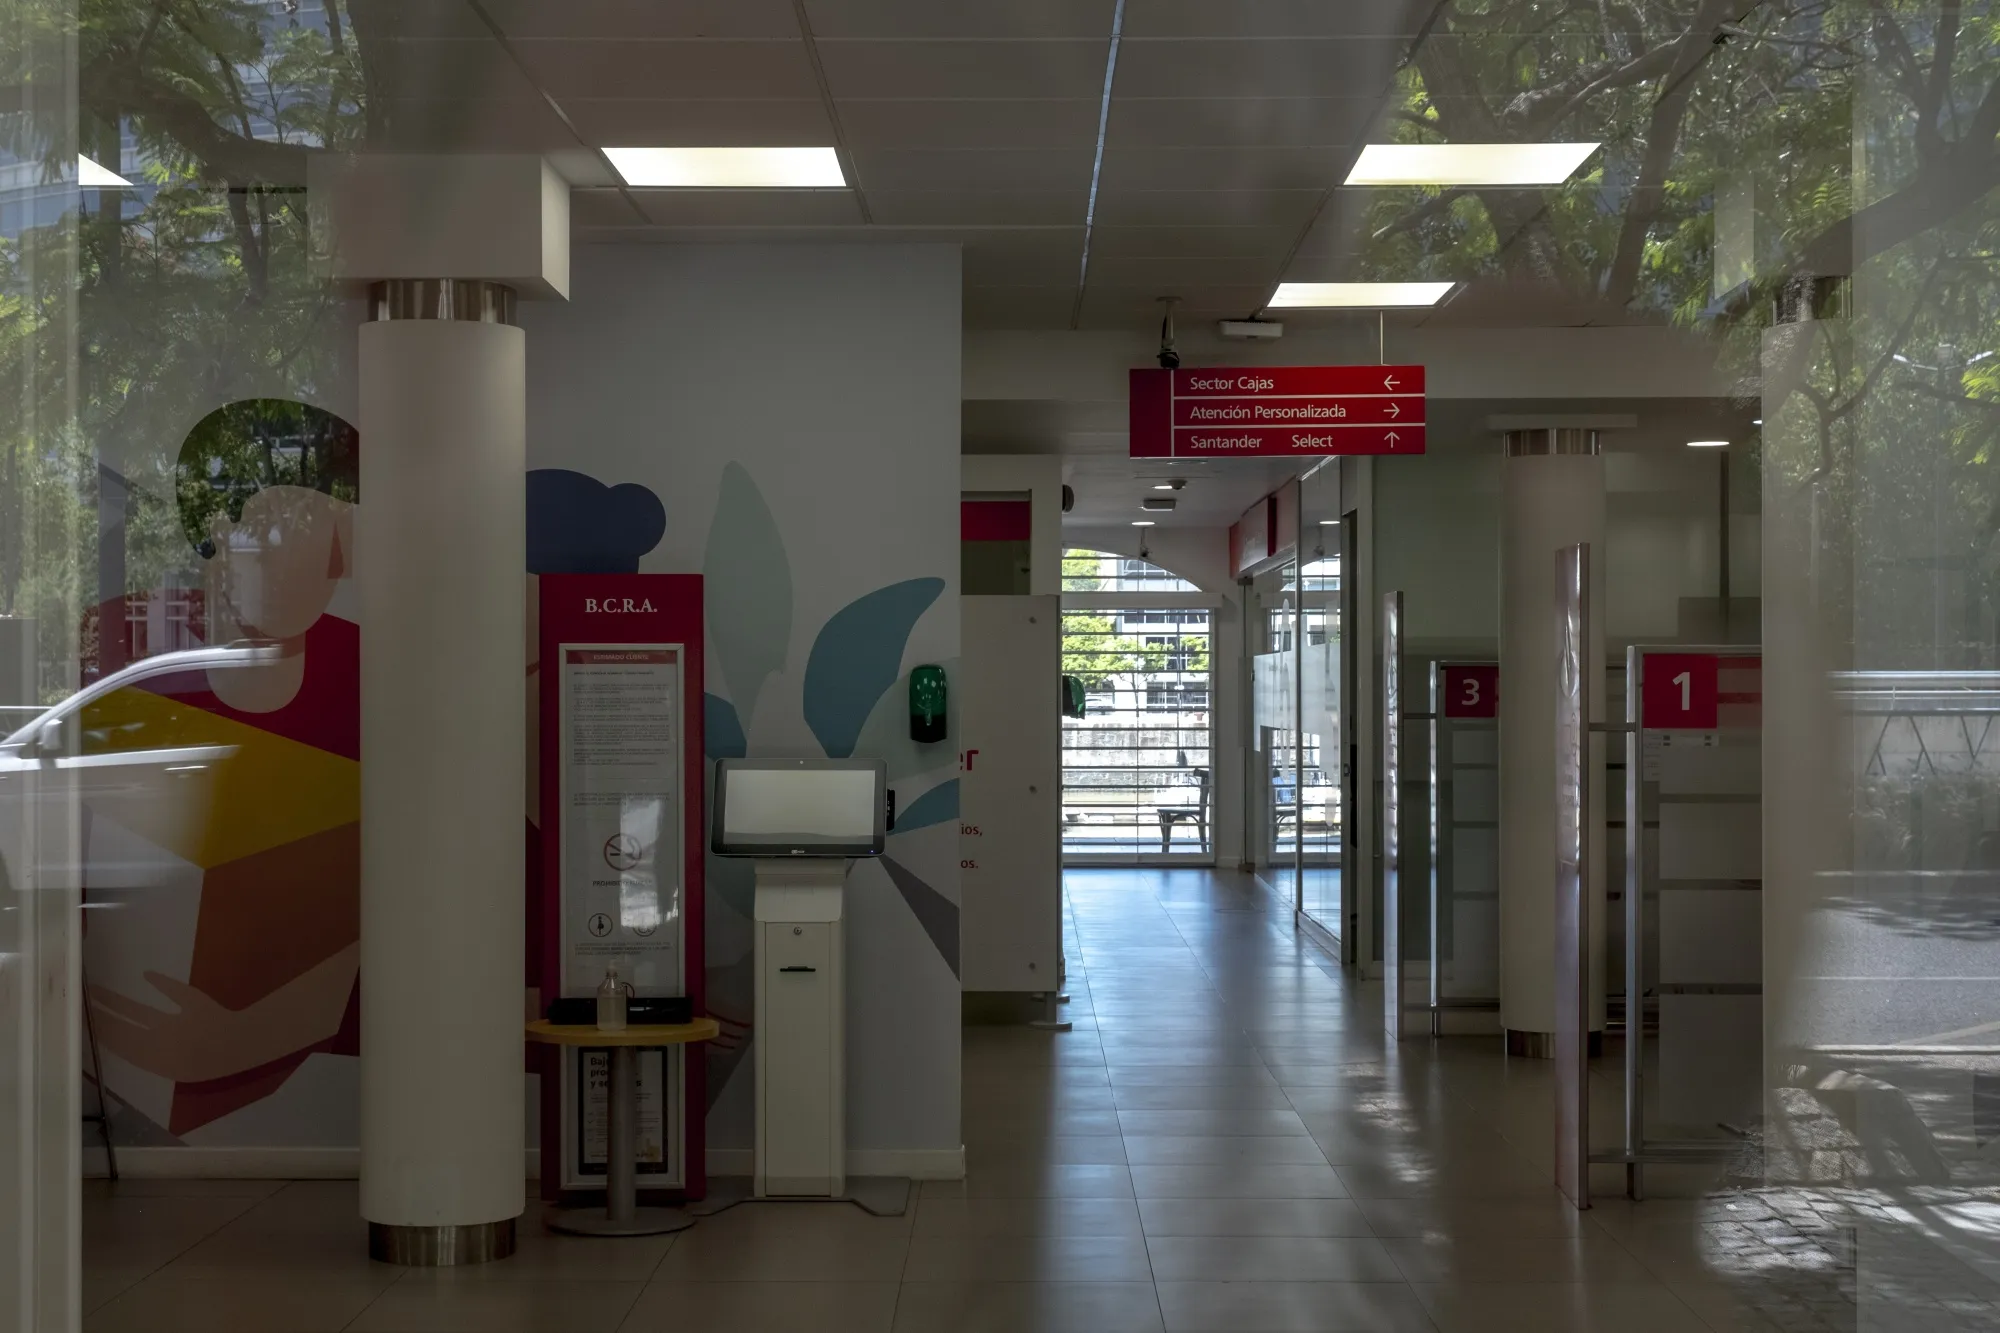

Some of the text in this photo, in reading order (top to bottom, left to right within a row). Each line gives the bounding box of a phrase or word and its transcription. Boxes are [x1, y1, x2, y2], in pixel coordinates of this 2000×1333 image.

[1190, 376, 1274, 393] Sector Cajas
[1190, 403, 1347, 420] Atención Personalizada
[1190, 434, 1333, 449] Santander Select
[585, 598, 658, 613] B.C.R.A.
[1461, 678, 1480, 706] 3
[1672, 671, 1691, 711] 1
[590, 1057, 608, 1068] Baj
